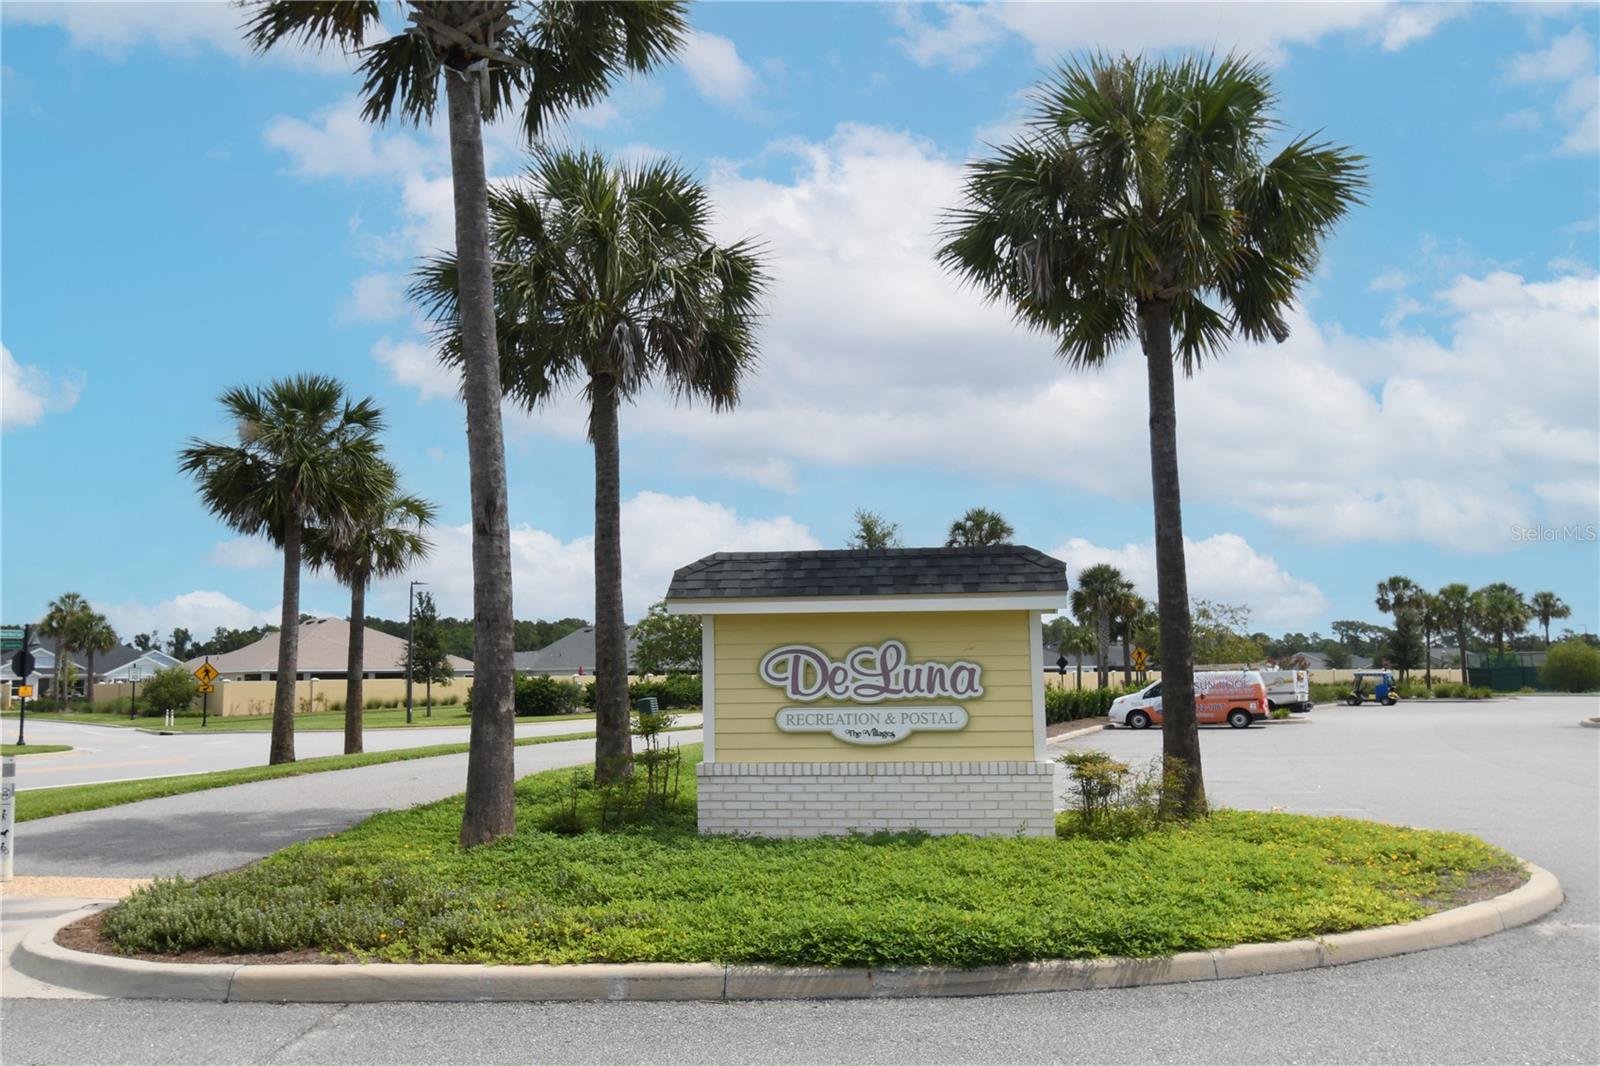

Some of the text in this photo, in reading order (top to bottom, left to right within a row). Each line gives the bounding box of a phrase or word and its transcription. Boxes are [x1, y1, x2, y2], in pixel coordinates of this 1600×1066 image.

[764, 643, 979, 698] DeLuna
[786, 711, 957, 726] RECREATION & POSTAL
[845, 728, 896, 739] The Villages
